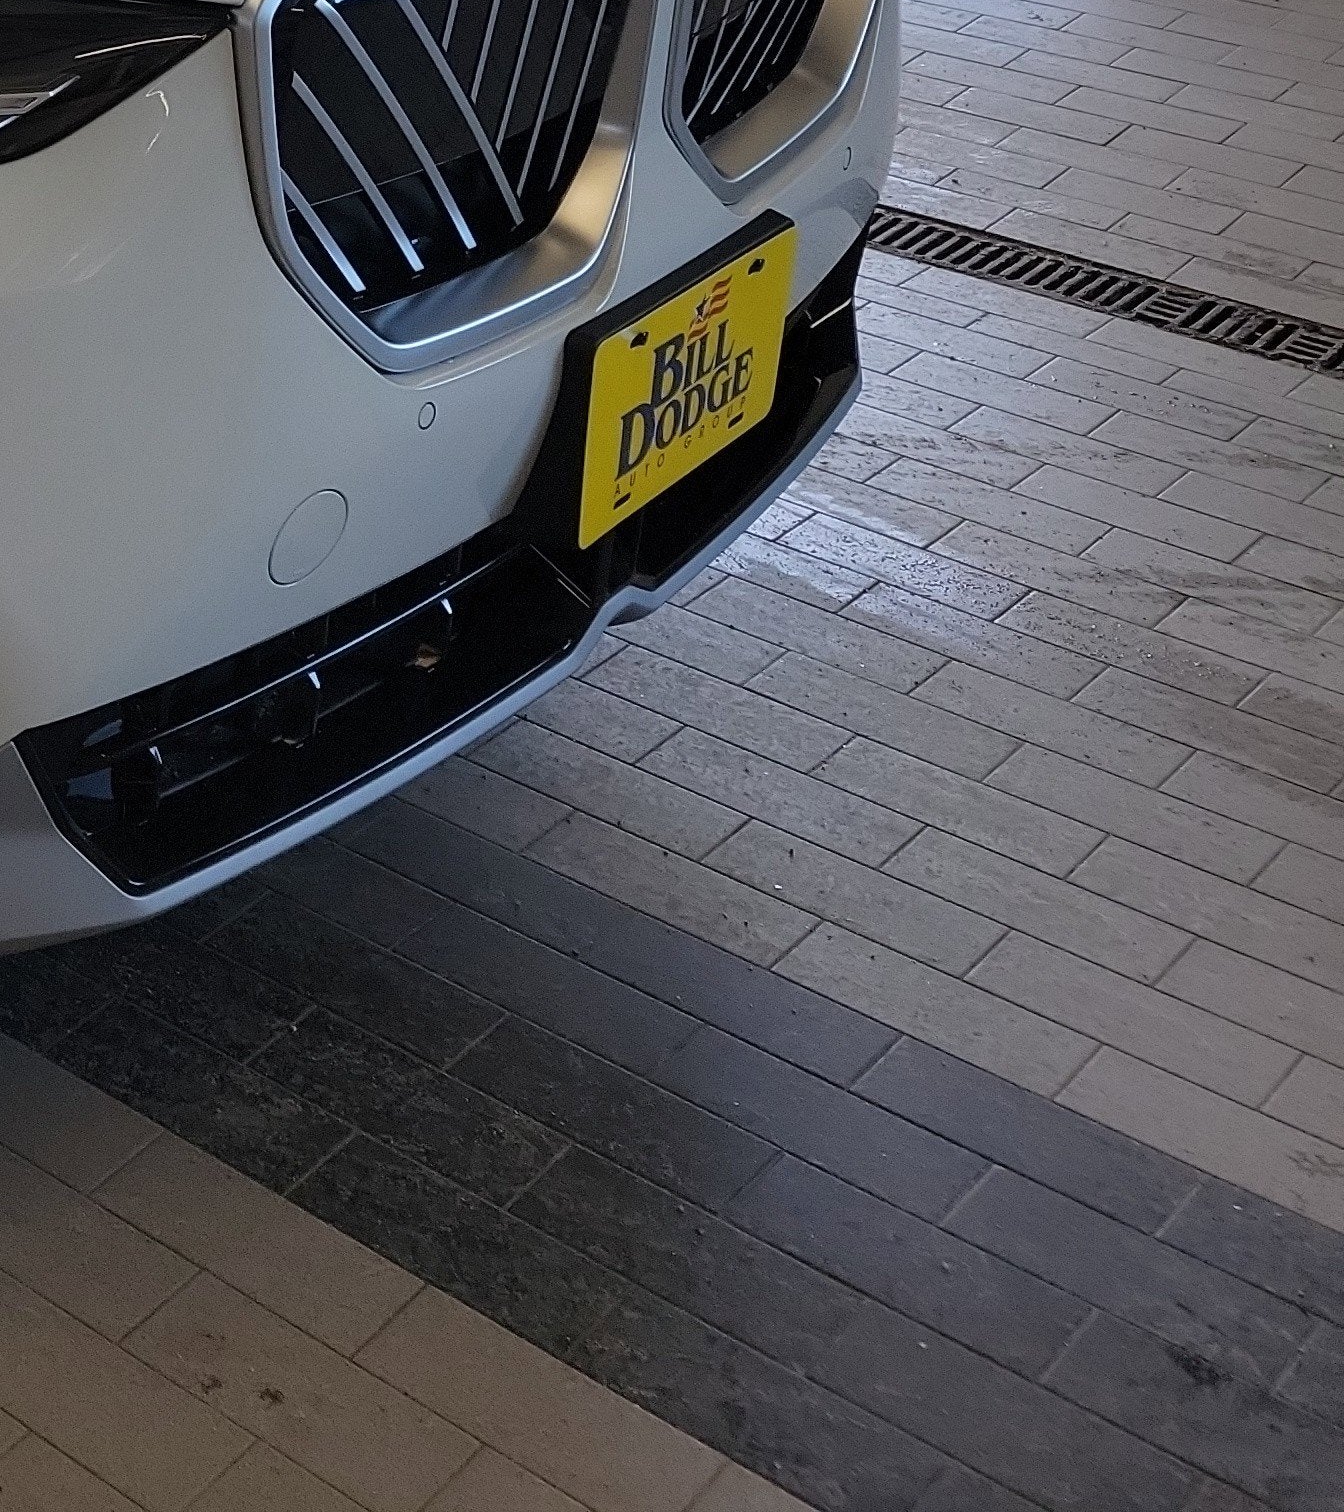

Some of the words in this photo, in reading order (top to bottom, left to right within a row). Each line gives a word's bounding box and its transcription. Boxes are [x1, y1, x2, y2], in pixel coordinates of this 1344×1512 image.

[614, 347, 754, 482] DODGE
[651, 319, 736, 410] BILL
[614, 453, 666, 495] AUTO
[683, 395, 747, 450] GROUP
